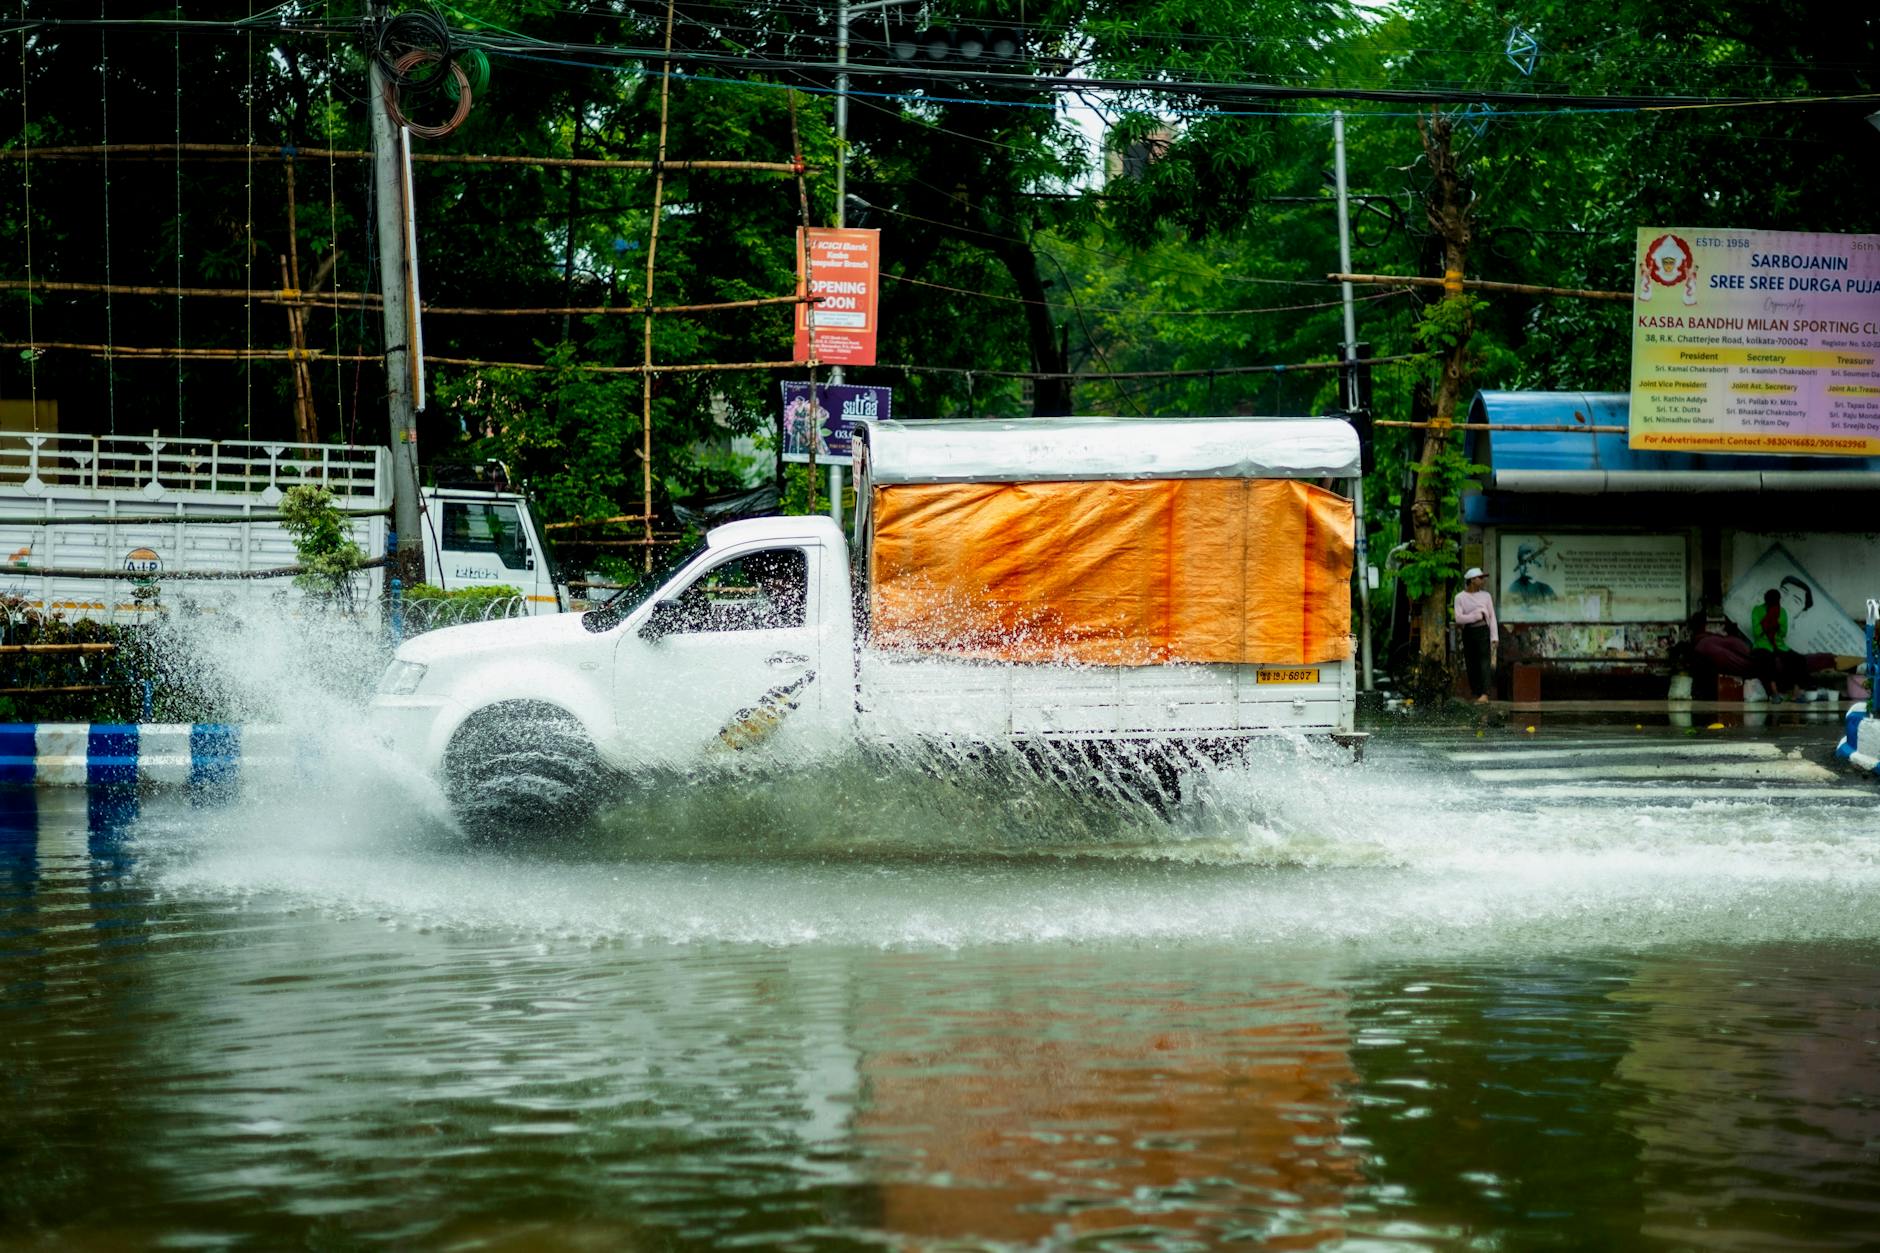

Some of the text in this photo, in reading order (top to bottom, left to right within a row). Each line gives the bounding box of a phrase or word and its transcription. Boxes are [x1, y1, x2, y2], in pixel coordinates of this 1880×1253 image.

[1696, 238, 1723, 247] ESTD:
[1751, 254, 1848, 271] SARBOJANIN
[811, 281, 866, 294] OPENING
[1710, 275, 1880, 293] SREE SREE DURGA PUJA
[817, 297, 856, 309] SOON
[1639, 316, 1880, 334] KASBA BANDHU MILAN SPORTING CL
[1677, 335, 1720, 345] Chatterjee
[1722, 336, 1745, 345] Road,
[1680, 352, 1718, 361] President
[1747, 354, 1786, 364] Secretary
[1837, 356, 1875, 365] Treasurer
[1639, 380, 1657, 388] Joint
[1674, 381, 1707, 389] President
[1765, 383, 1797, 392] Secretary
[1644, 435, 1658, 444] For
